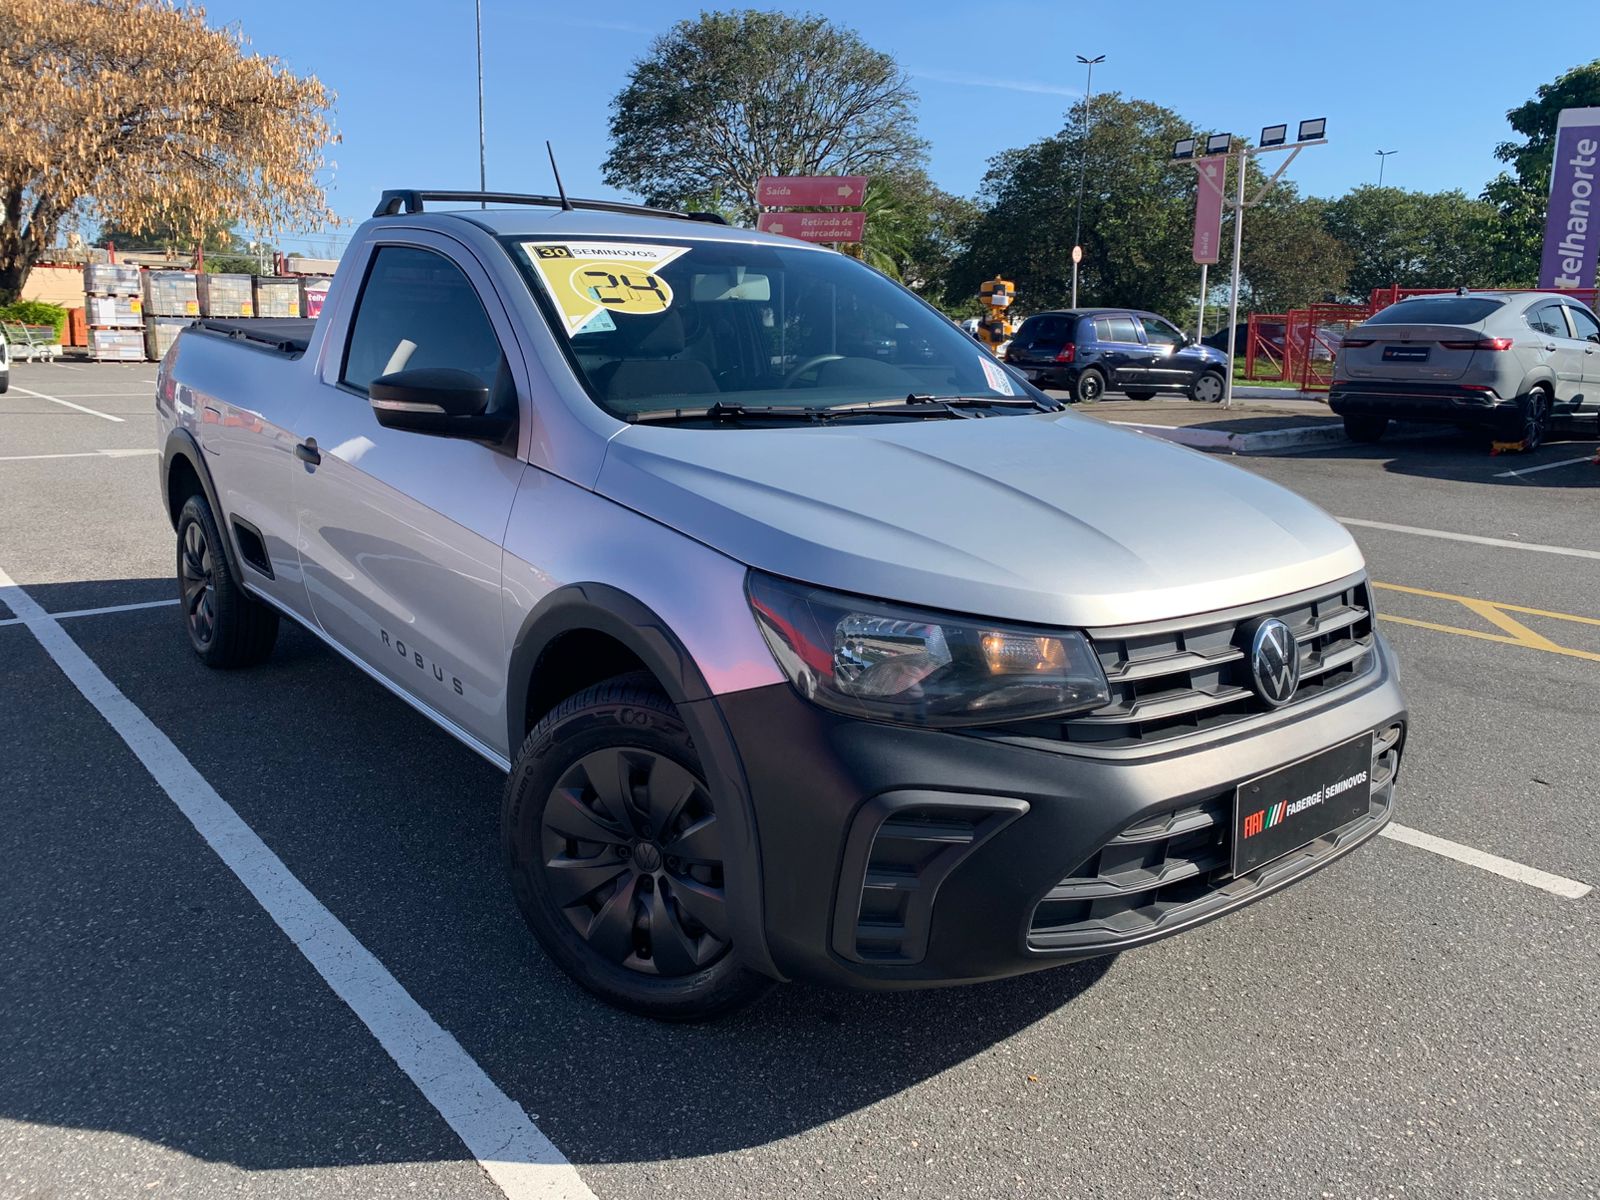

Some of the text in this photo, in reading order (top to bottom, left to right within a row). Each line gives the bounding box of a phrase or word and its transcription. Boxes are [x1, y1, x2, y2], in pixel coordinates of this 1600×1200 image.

[766, 186, 791, 196] Saída
[1554, 138, 1598, 289] telhanorte
[801, 218, 853, 226] Retirada de
[801, 229, 851, 237] mercadoria
[573, 248, 657, 258] SEMINOVOS
[381, 629, 463, 695] ROBUS
[1244, 810, 1265, 839] FIAT
